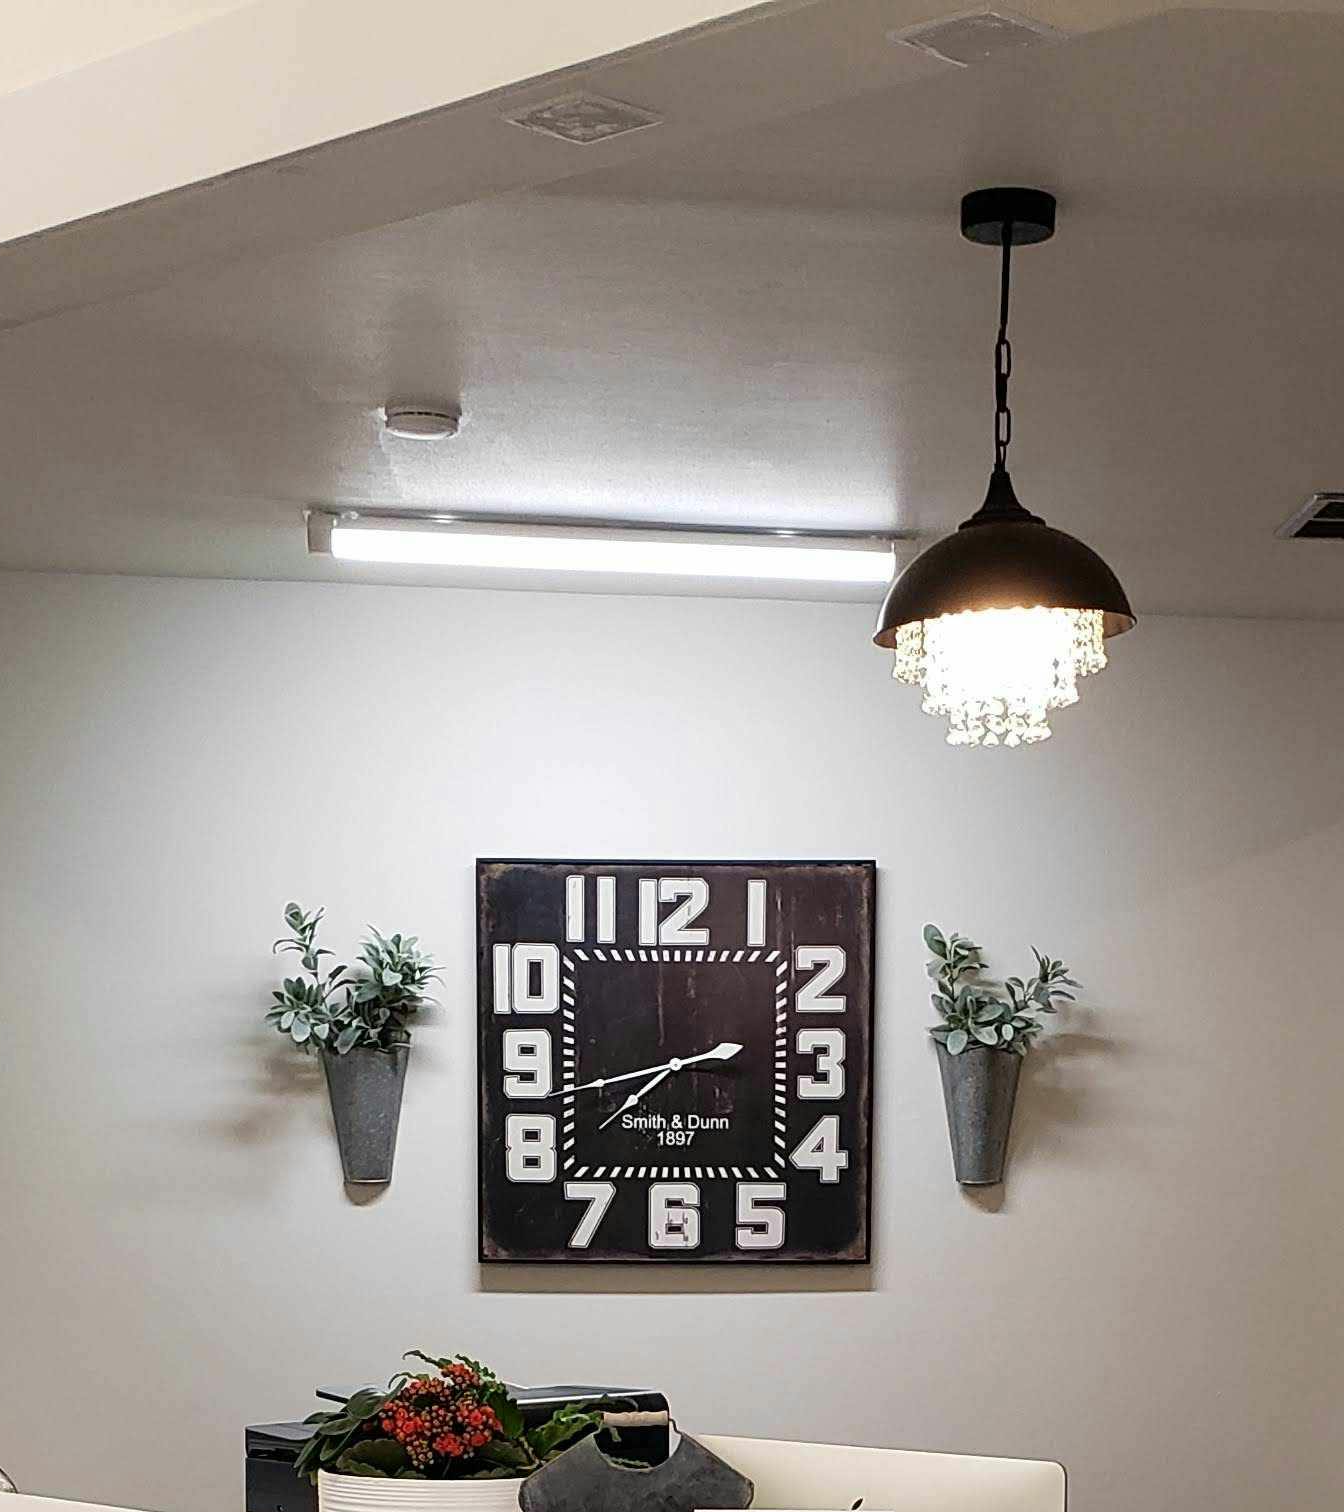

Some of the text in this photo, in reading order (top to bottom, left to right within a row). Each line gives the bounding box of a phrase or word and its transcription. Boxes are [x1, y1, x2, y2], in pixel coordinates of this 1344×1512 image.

[566, 874, 616, 943] 11
[638, 877, 710, 946] 12
[747, 879, 766, 946] 1
[493, 943, 559, 1015] 10
[795, 945, 846, 1013] 2
[502, 1028, 552, 1099] 9
[796, 1027, 846, 1100] 3
[506, 1113, 557, 1183] 8
[621, 1114, 729, 1130] Smith & Dunn
[656, 1130, 695, 1146] 1897
[789, 1115, 848, 1184] 4
[564, 1181, 616, 1249] 7
[648, 1183, 700, 1250] 6
[736, 1182, 787, 1250] 5
